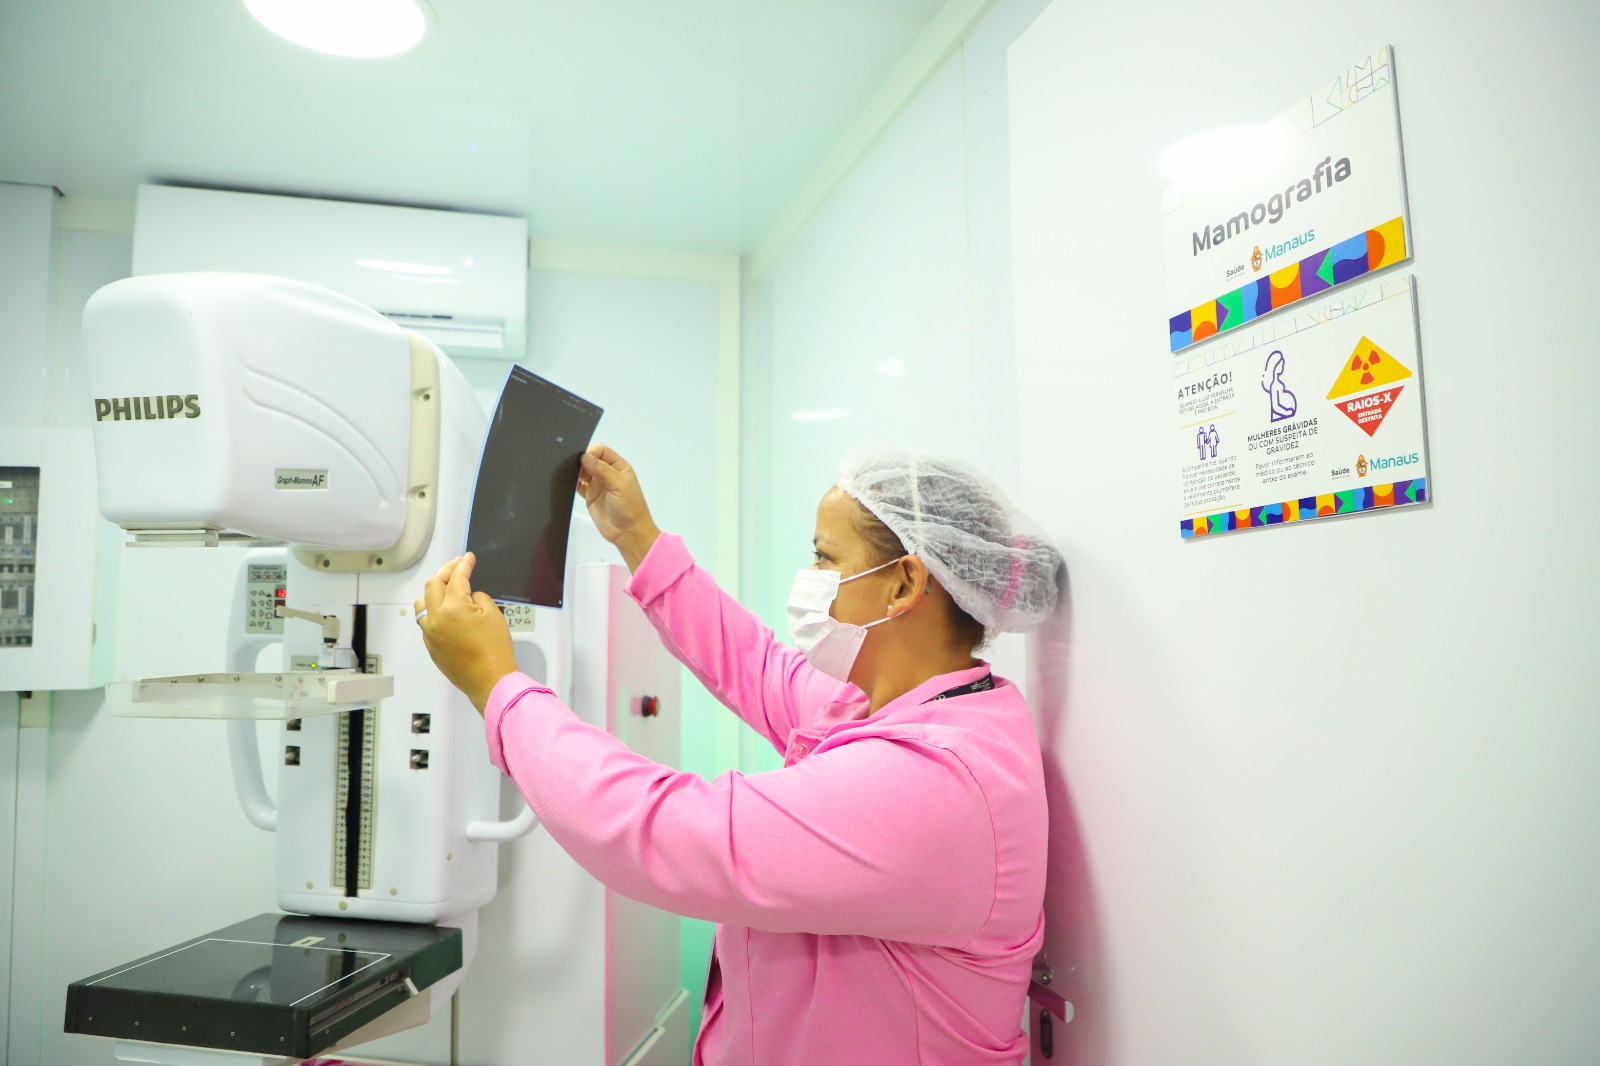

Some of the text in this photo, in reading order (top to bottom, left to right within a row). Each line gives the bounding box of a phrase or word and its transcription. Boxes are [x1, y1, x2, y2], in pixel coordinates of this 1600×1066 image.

[1192, 156, 1351, 256] Mamografia
[1265, 229, 1315, 262] Manaus
[1178, 371, 1232, 399] ATENÇÃO!
[95, 394, 200, 421] PHILIPS
[1347, 392, 1392, 412] RAIOS-X
[1357, 408, 1382, 418] ENTRADA
[1358, 414, 1383, 424] RESTRITA
[1247, 418, 1318, 442] MULHERES GRÁVIDAS
[1259, 439, 1274, 448] COM
[1275, 430, 1307, 444] SUSPEITA
[1309, 427, 1318, 435] DE
[1266, 441, 1299, 455] GRAVIDEZ
[1255, 462, 1270, 470] Favor
[1271, 454, 1305, 466] informarem
[1331, 453, 1419, 476] Saúde Manaus
[1262, 476, 1278, 484] antes
[1279, 473, 1286, 481] do
